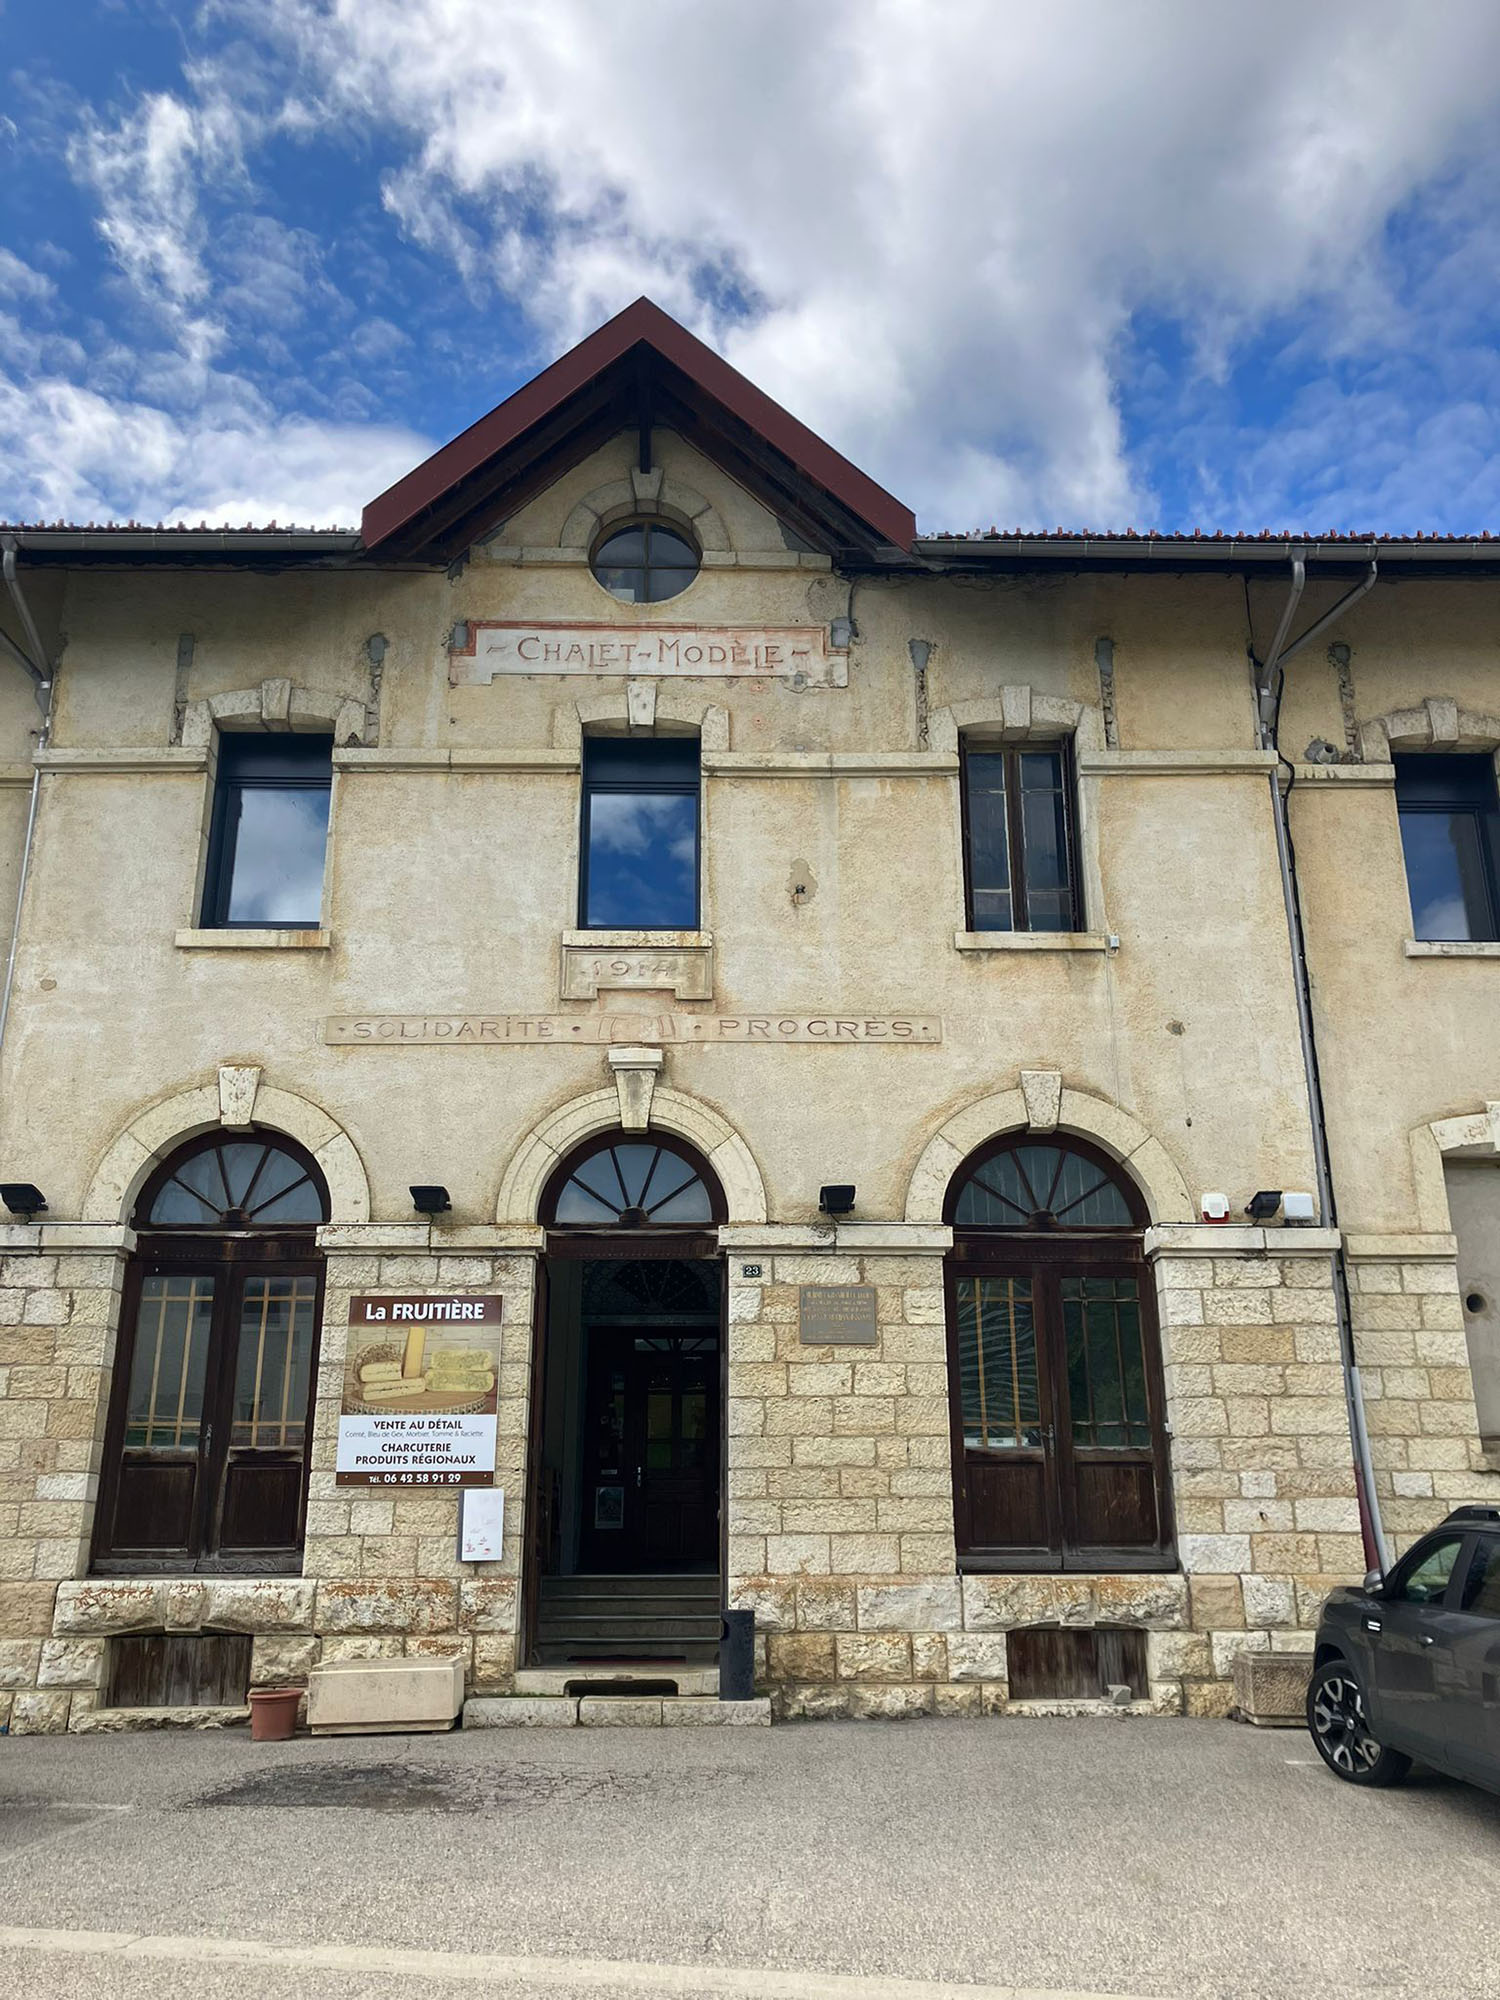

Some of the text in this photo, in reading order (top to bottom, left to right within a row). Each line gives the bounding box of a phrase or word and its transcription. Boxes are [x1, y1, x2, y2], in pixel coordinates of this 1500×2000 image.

[718, 1016, 913, 1038] PROGRÈS
[745, 1266, 759, 1275] 23
[365, 1299, 485, 1320] La FRUITIÈRE
[373, 1418, 463, 1430] VENTE AU DÉTAIL
[381, 1443, 452, 1453] CHARCUTERIE
[355, 1453, 476, 1465] PRODUITS RÉGIONAUX
[384, 1473, 397, 1483] 06
[400, 1473, 413, 1483] 42
[416, 1473, 429, 1483] 58
[432, 1473, 444, 1483] 91
[448, 1473, 461, 1483] 29
